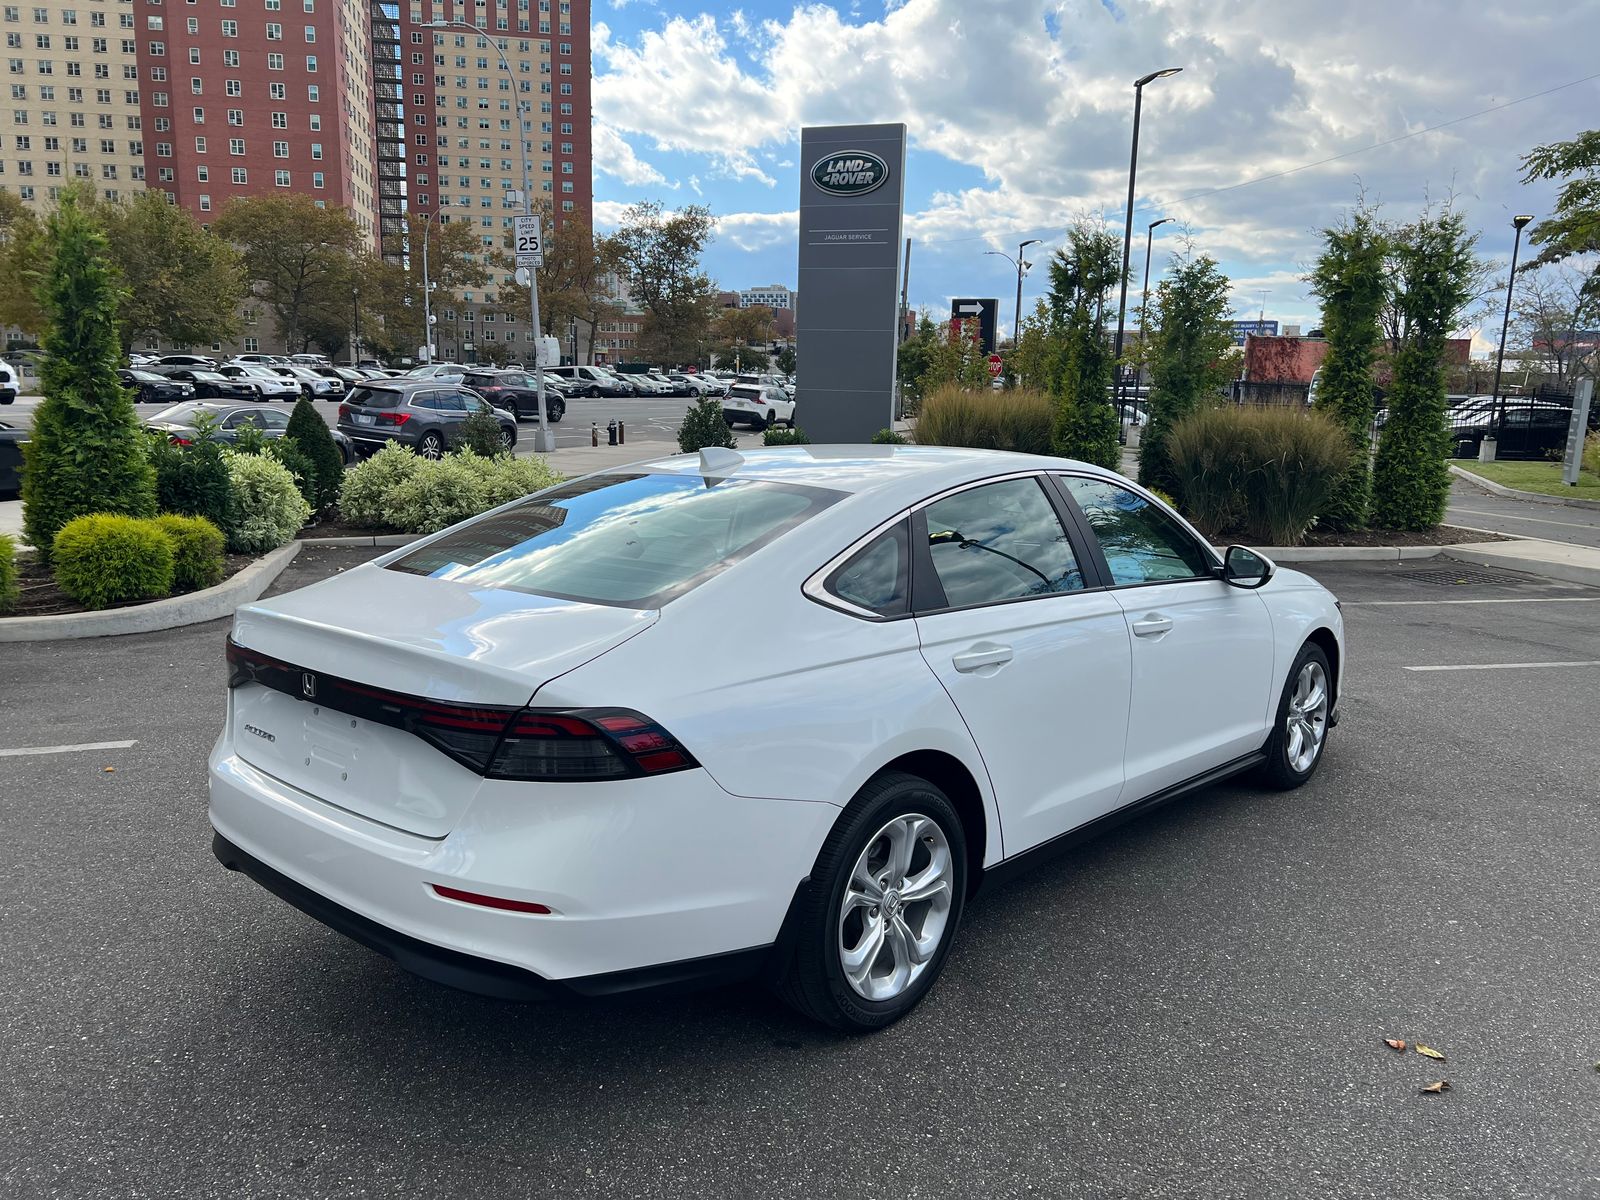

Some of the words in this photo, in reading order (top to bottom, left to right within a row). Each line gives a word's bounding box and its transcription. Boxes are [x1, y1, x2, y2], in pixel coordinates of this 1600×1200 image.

[826, 160, 864, 173] LAND
[829, 172, 875, 185] ROVER
[518, 236, 539, 251] 25
